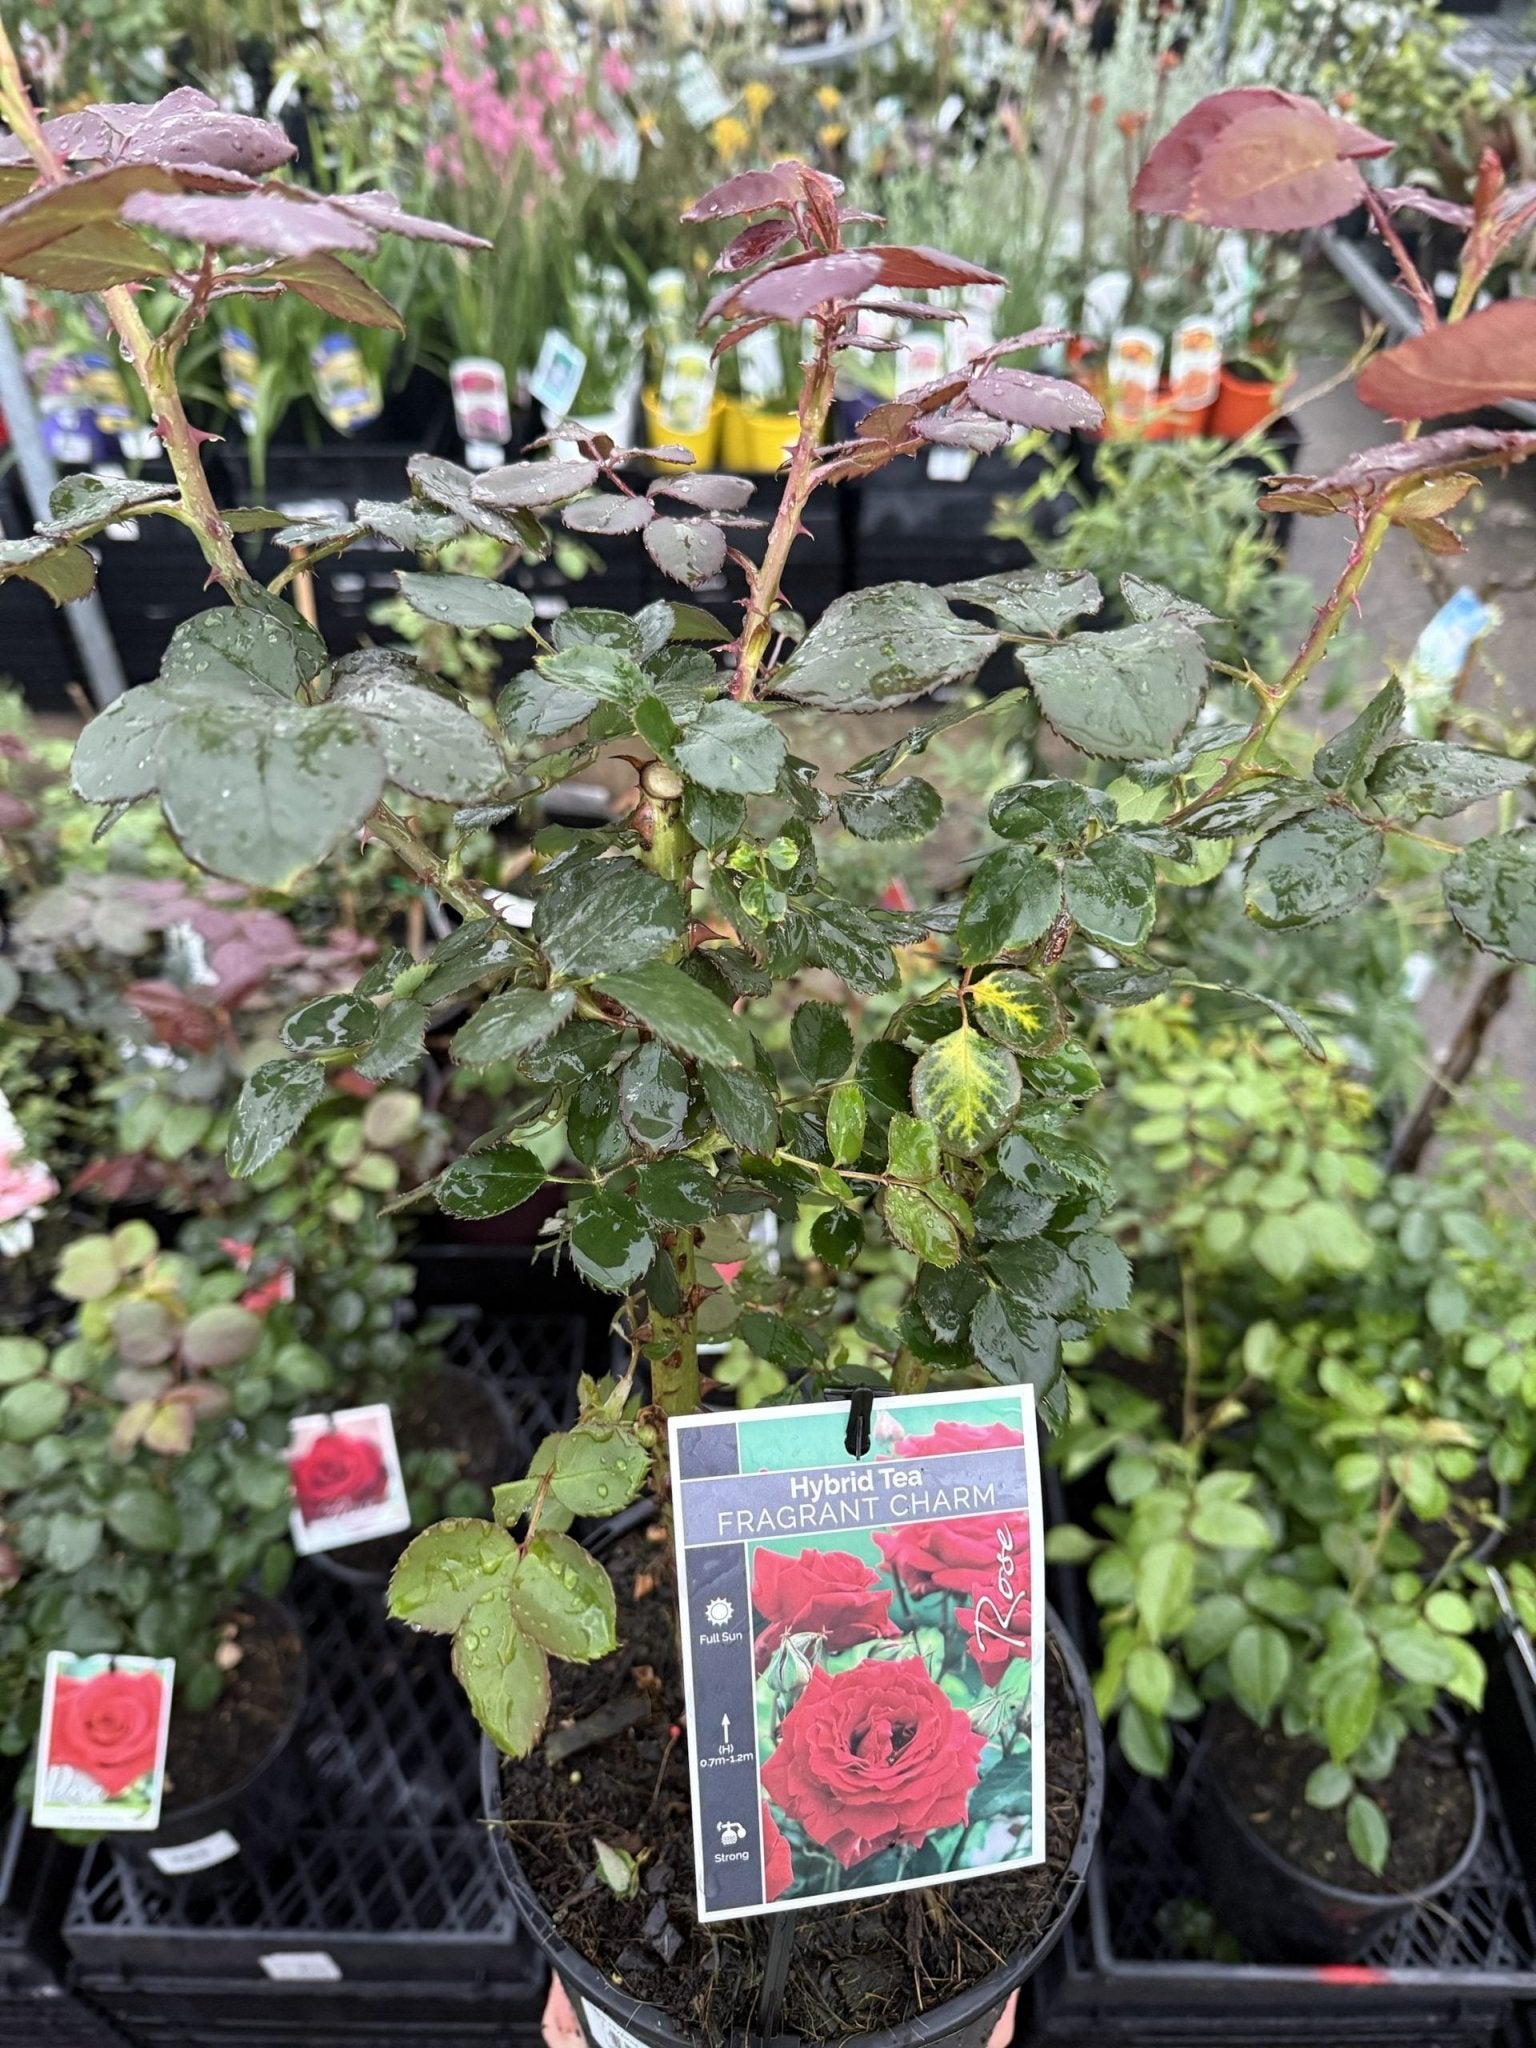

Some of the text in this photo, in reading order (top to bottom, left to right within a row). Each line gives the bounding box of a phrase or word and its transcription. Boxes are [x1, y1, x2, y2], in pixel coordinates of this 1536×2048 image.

[789, 1467, 923, 1503] Hybrid Tea
[718, 1482, 996, 1536] FRAGRANT CHARM
[973, 1521, 1026, 1653] Rose
[699, 1631, 743, 1645] Full Sun
[718, 1743, 735, 1755] (H)
[699, 1752, 754, 1768] 0.7m-1.2m
[714, 1851, 750, 1863] Strong
